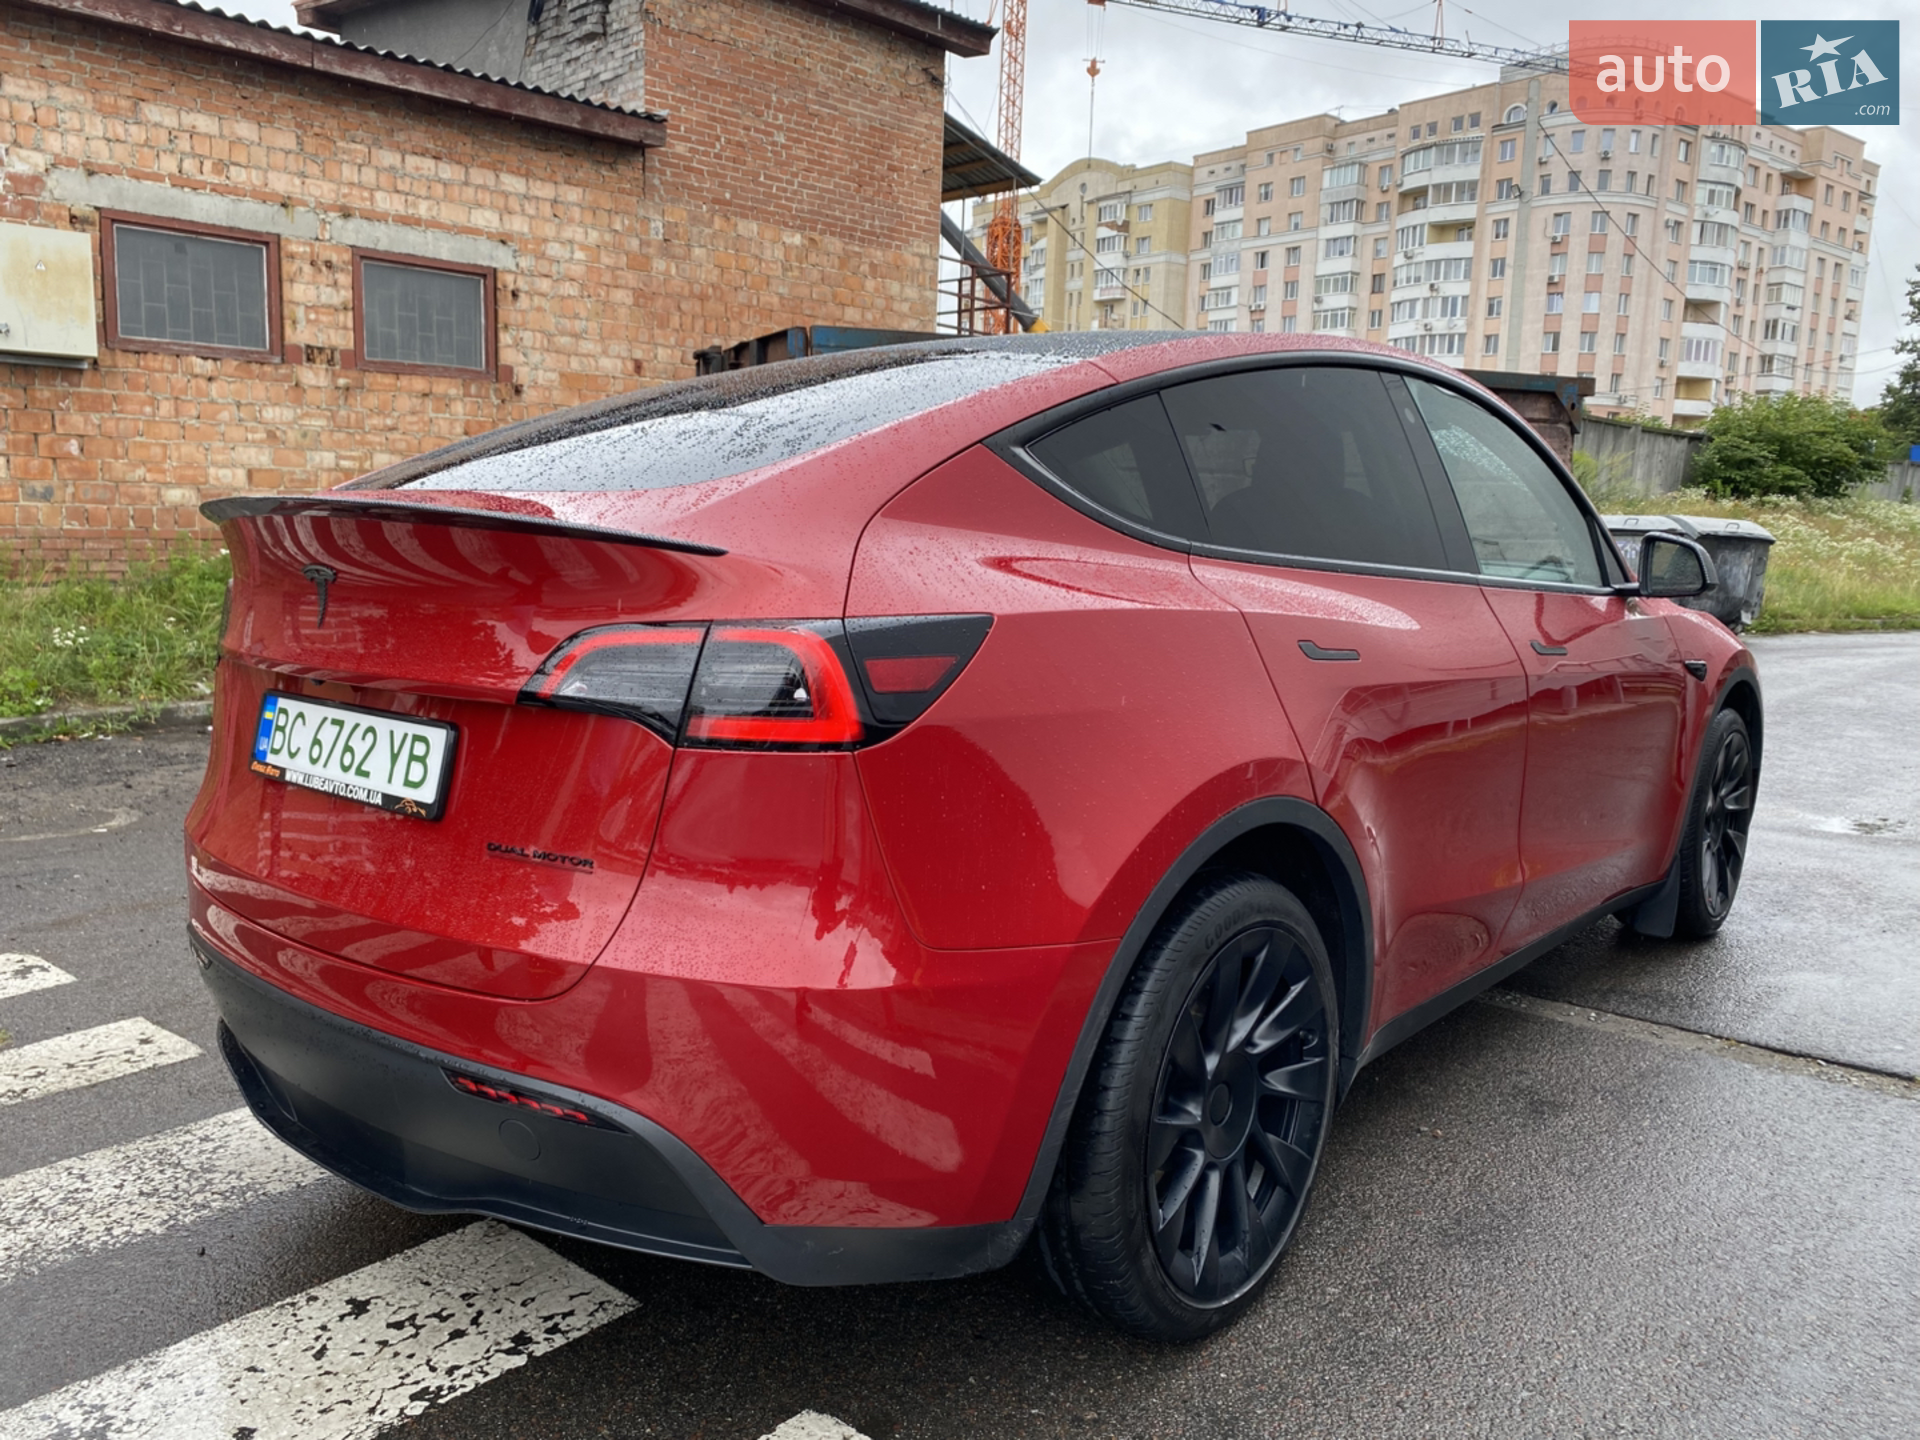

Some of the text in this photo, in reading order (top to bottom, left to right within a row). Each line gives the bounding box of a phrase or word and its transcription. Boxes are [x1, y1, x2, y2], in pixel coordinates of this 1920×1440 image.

[270, 706, 431, 789] BC 6762 YB
[284, 769, 383, 806] WWW.LUBEAVTO.COM.UA
[487, 842, 594, 869] DUAL MOTOR
